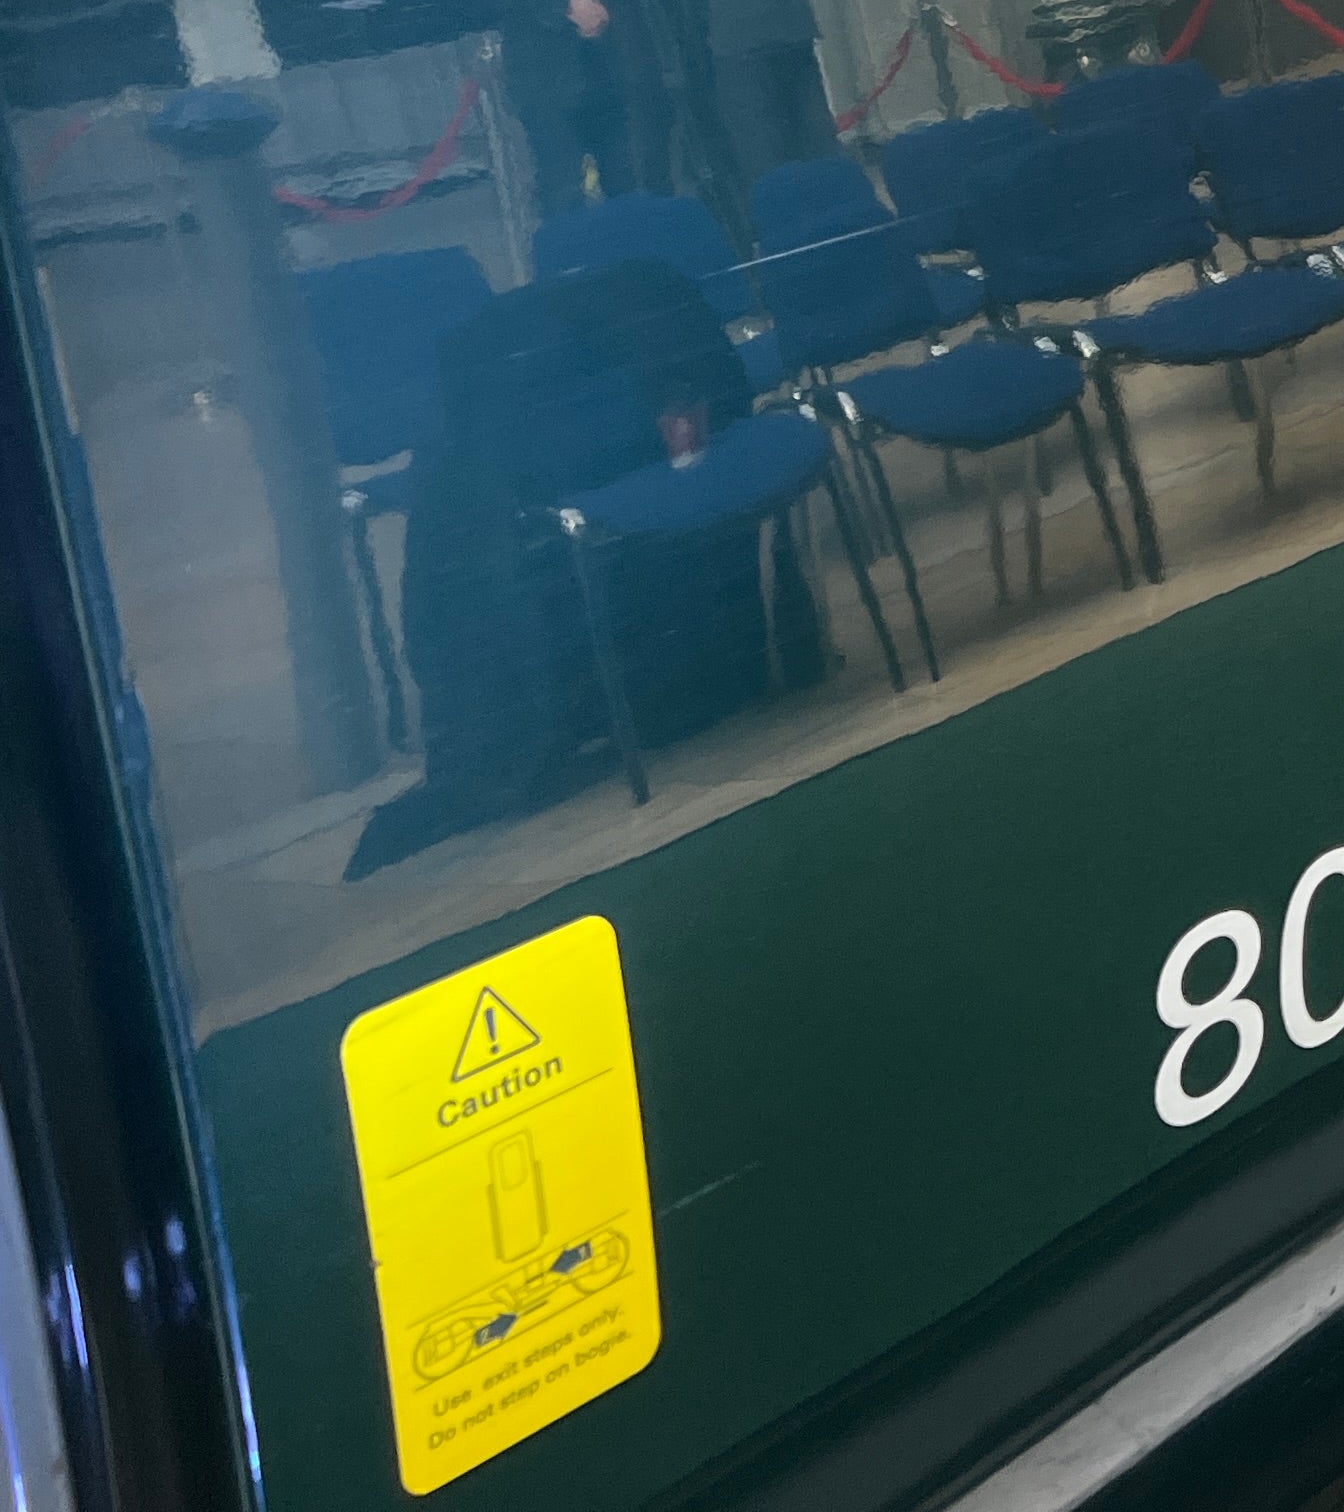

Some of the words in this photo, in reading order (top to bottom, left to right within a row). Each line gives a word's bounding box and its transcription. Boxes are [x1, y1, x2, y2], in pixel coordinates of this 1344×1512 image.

[436, 1056, 563, 1129] Caution
[428, 1427, 457, 1451] Do
[462, 1403, 494, 1431] not
[500, 1379, 541, 1411] step
[545, 1363, 570, 1384] on
[432, 1389, 472, 1417] Use
[482, 1361, 519, 1391] exit
[522, 1332, 574, 1368] steps
